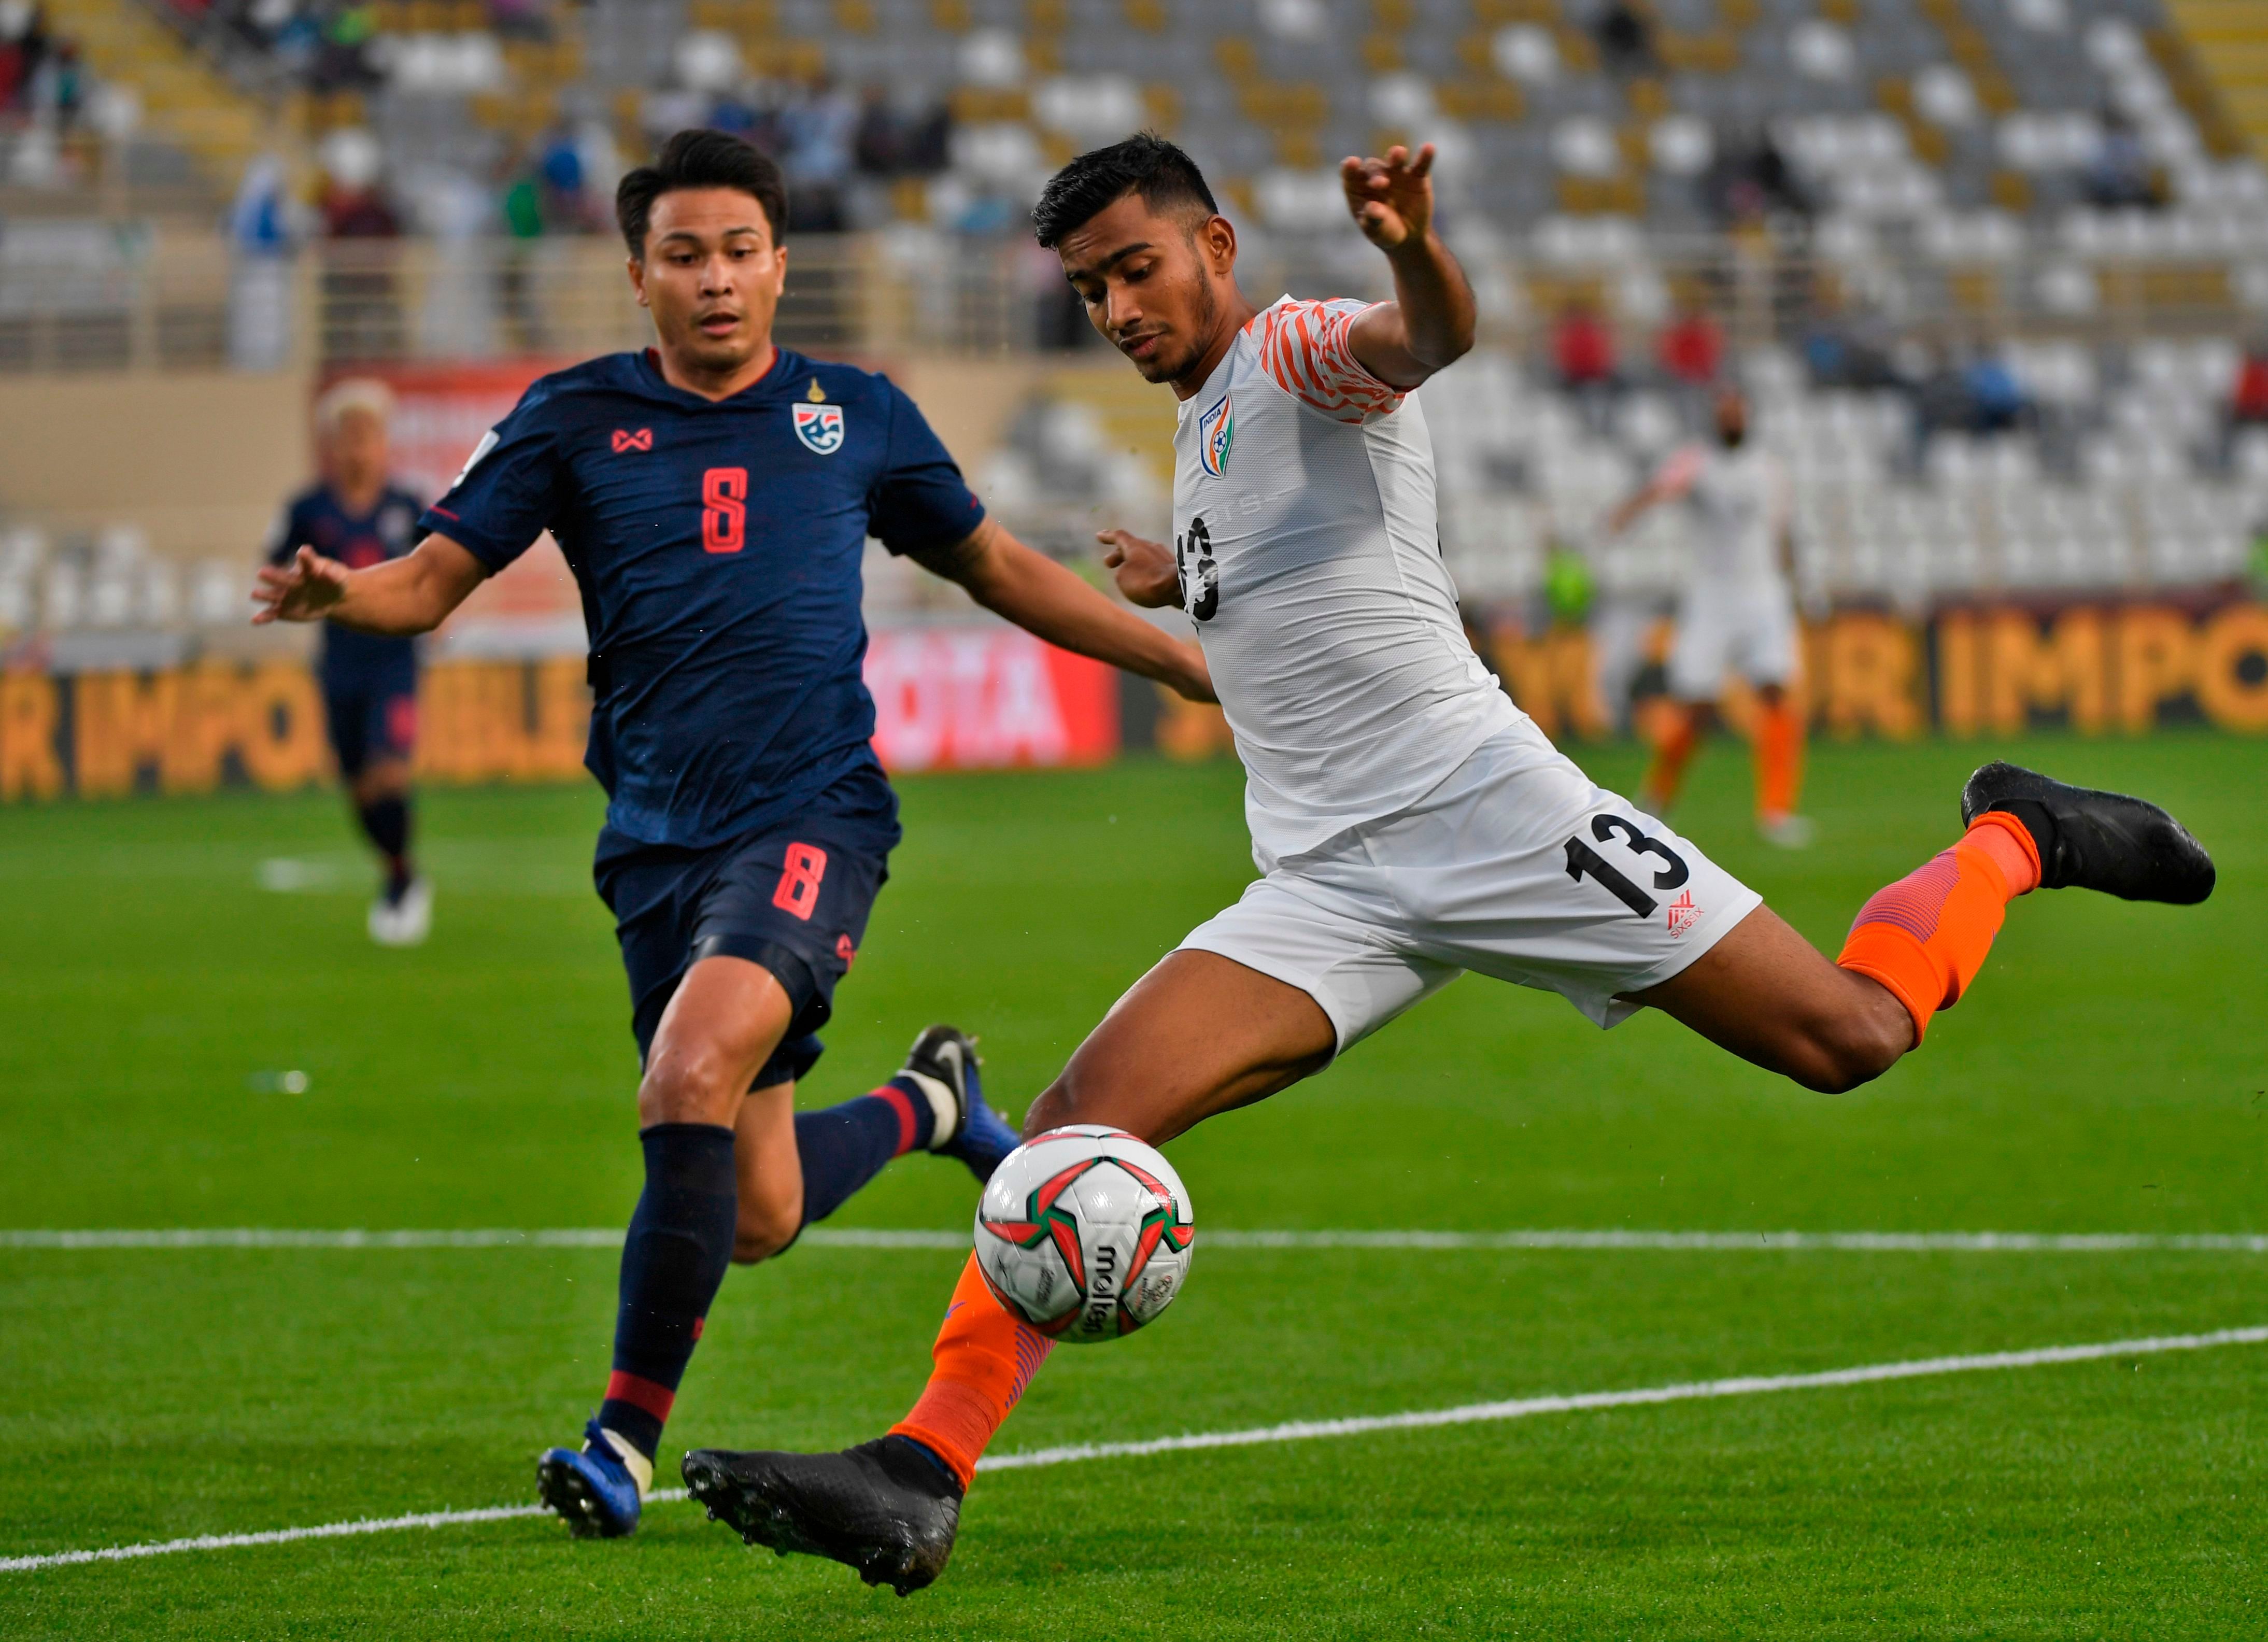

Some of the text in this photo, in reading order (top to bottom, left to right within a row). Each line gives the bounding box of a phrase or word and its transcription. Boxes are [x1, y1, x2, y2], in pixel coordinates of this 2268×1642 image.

[1204, 408, 1222, 429] INDIA
[702, 468, 748, 554] 8
[772, 842, 828, 922] 8
[1564, 814, 1689, 919] 13
